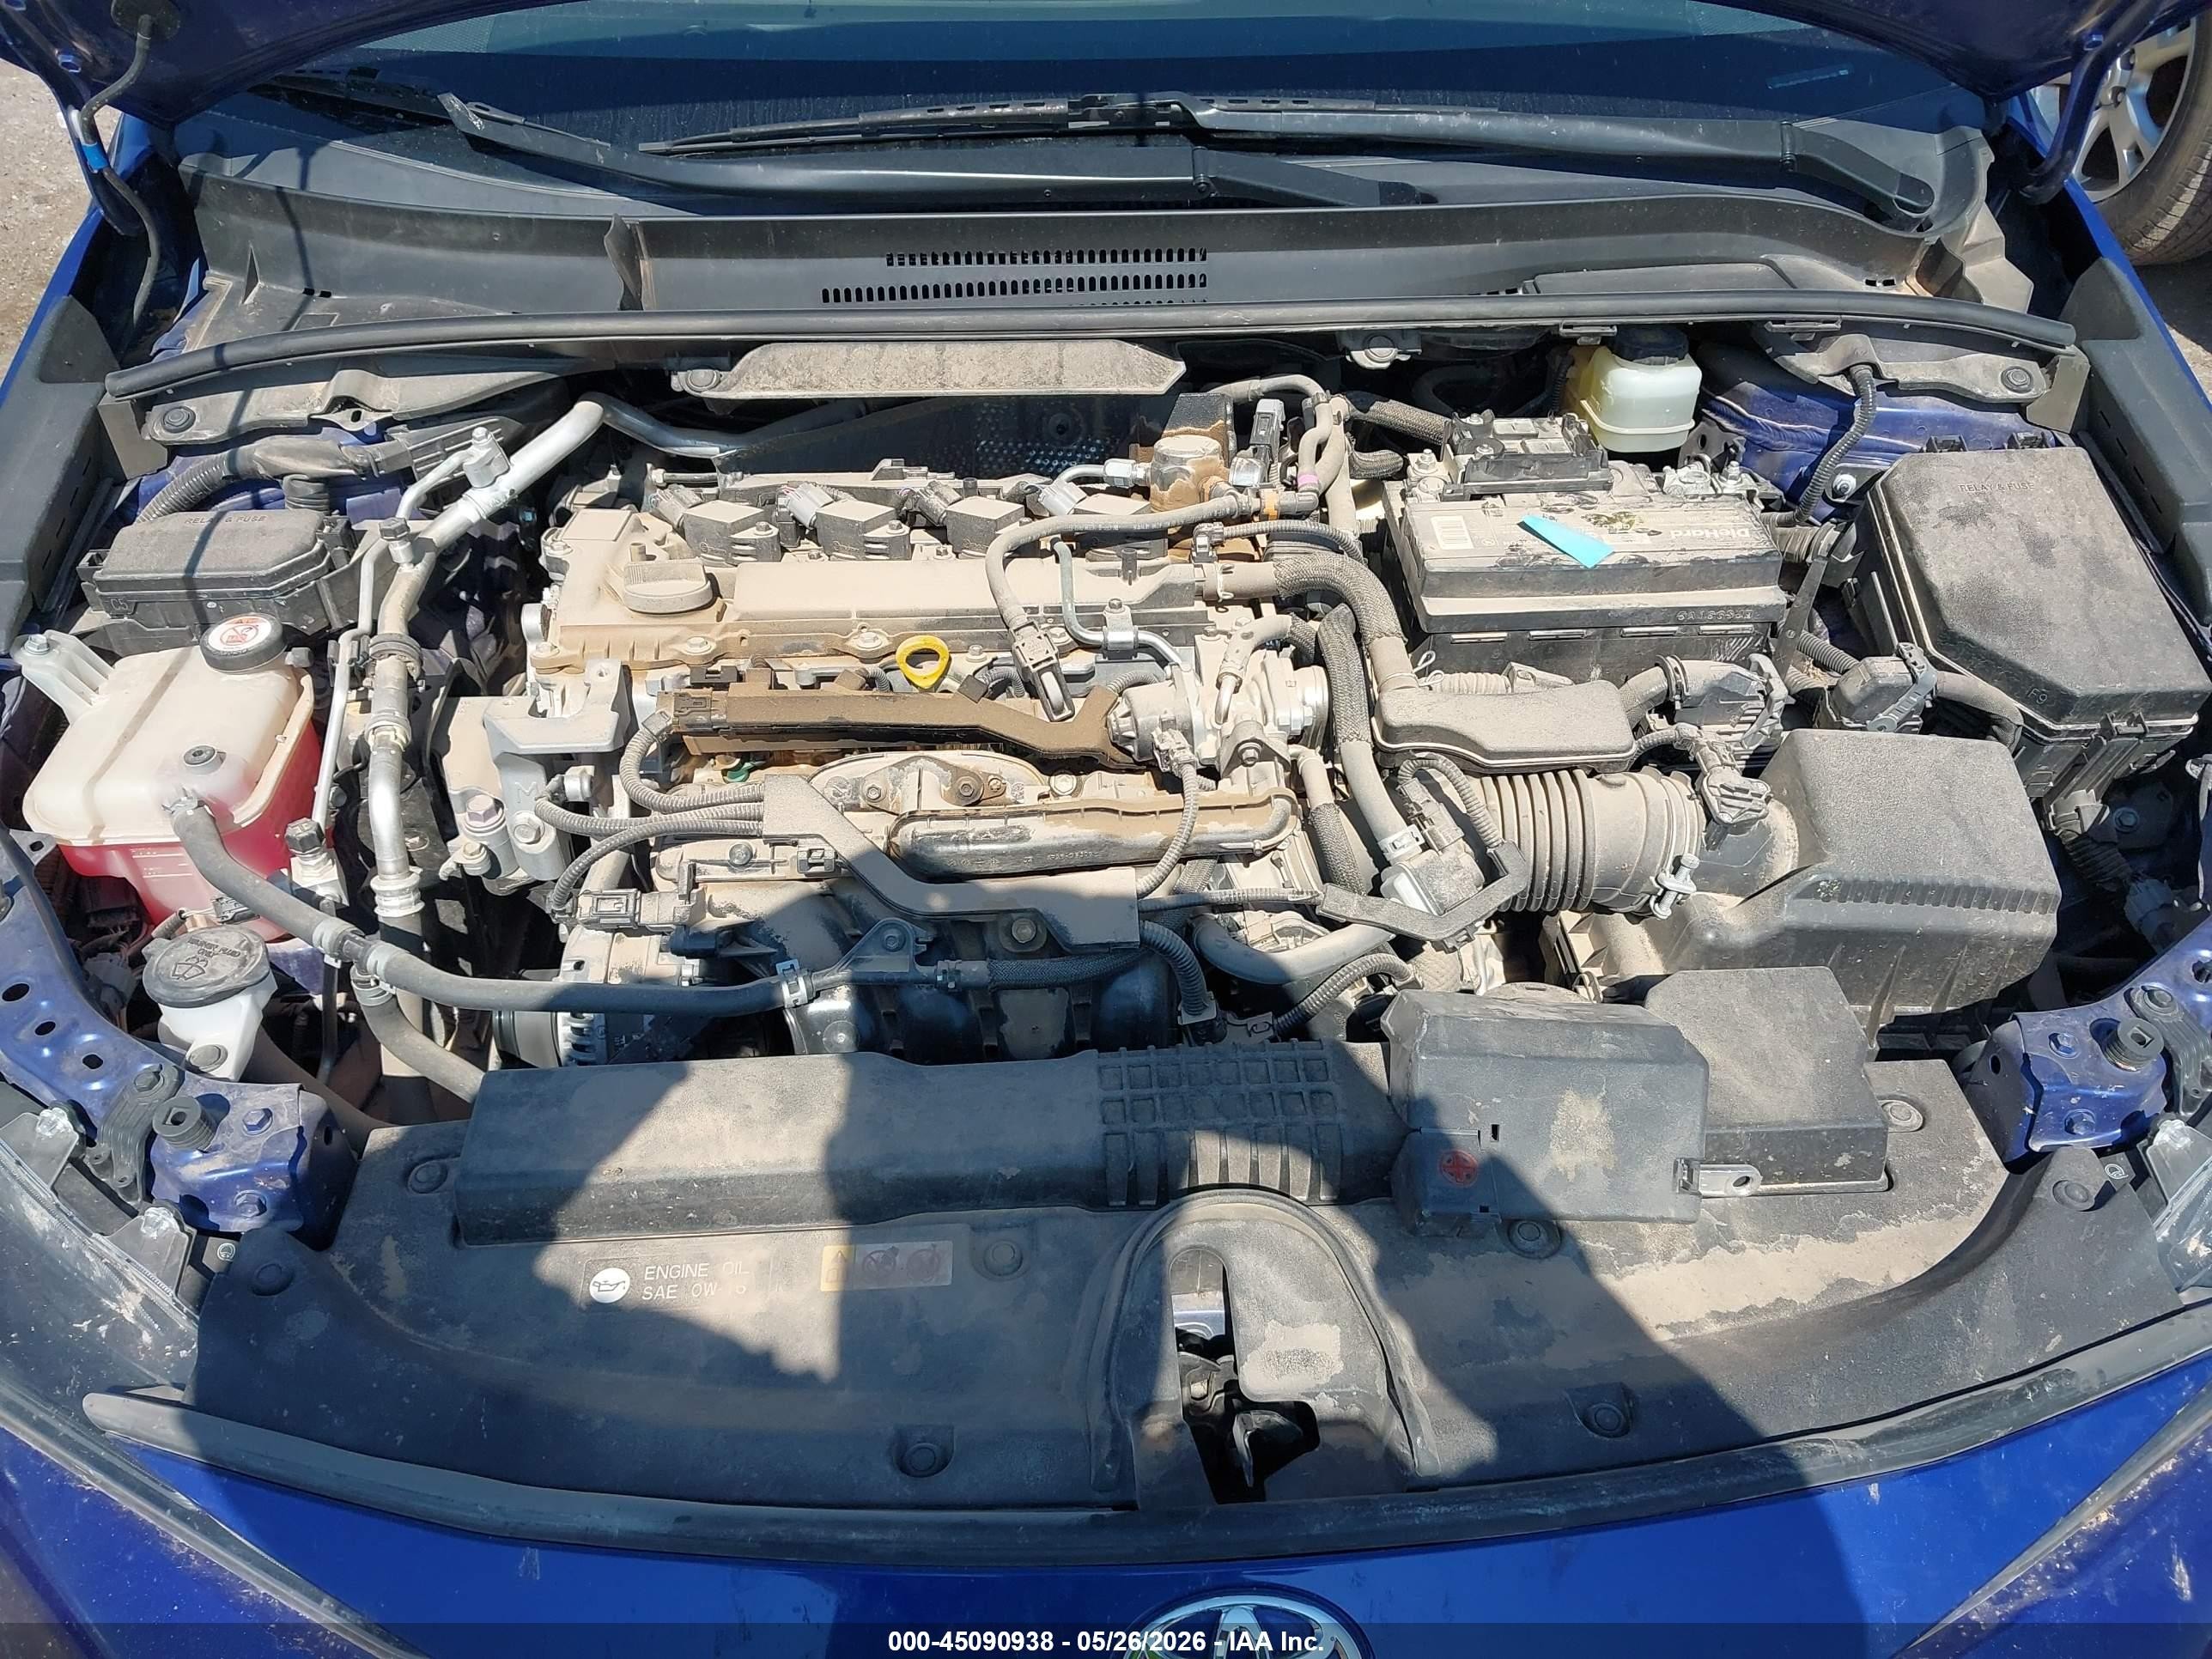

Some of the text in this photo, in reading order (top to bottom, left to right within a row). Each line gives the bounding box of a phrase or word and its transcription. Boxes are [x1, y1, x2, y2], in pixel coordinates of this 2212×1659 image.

[2007, 482, 2034, 490] FUSE
[1670, 527, 1750, 538] DieHard
[644, 1261, 750, 1280] ENGINE OIL
[641, 1284, 678, 1300] SAE
